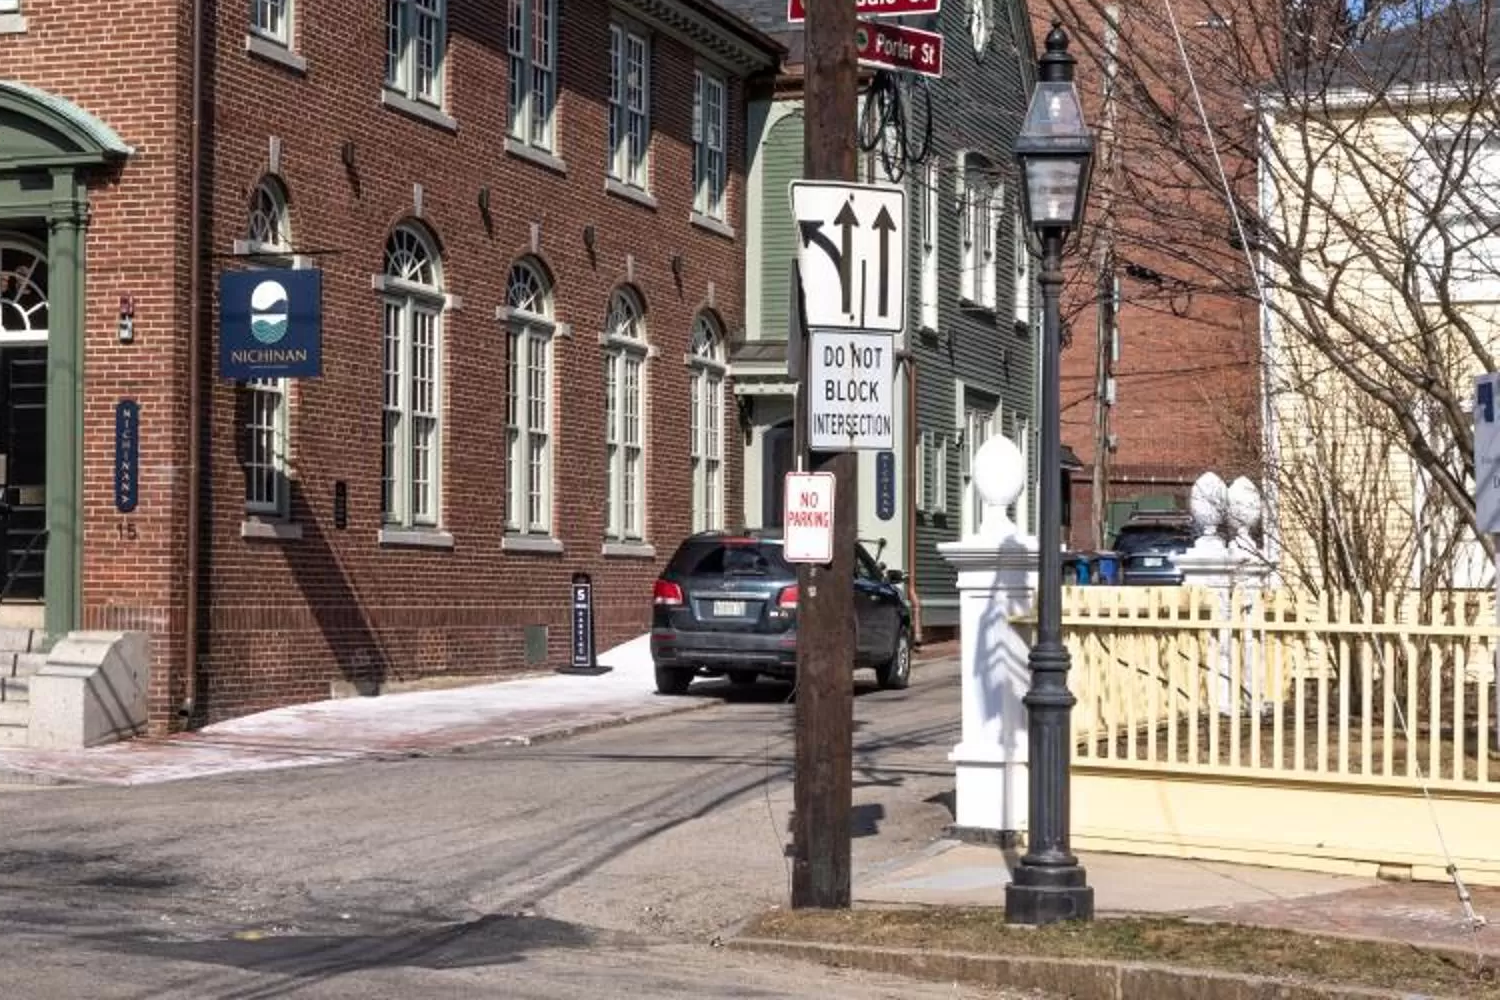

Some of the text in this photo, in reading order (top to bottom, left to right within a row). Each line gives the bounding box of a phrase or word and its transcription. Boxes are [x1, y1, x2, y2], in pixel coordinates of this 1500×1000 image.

[875, 32, 935, 65] Porter St
[231, 348, 307, 364] NICHINAN
[824, 345, 883, 368] DO NOT
[825, 379, 879, 402] BLOCK
[814, 413, 891, 436] INTERSECTION
[800, 491, 819, 508] NO
[788, 511, 829, 528] PARKING
[117, 523, 137, 540] 15
